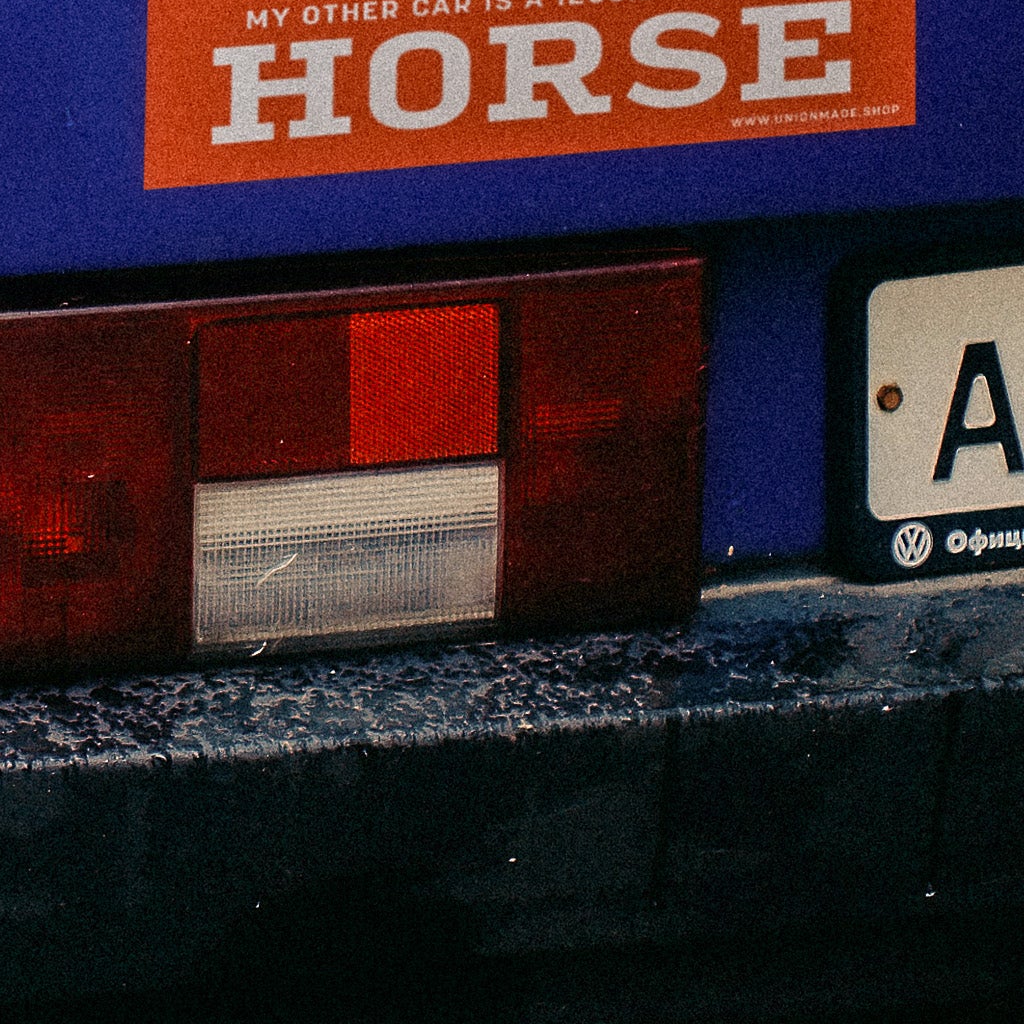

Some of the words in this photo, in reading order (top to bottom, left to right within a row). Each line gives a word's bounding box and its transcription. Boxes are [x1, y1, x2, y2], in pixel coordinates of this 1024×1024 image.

[246, 7, 290, 30] MY
[302, 0, 399, 25] OTHER
[211, 0, 852, 145] HORSE
[932, 340, 1024, 482] A
[947, 527, 1024, 556] Офиц
